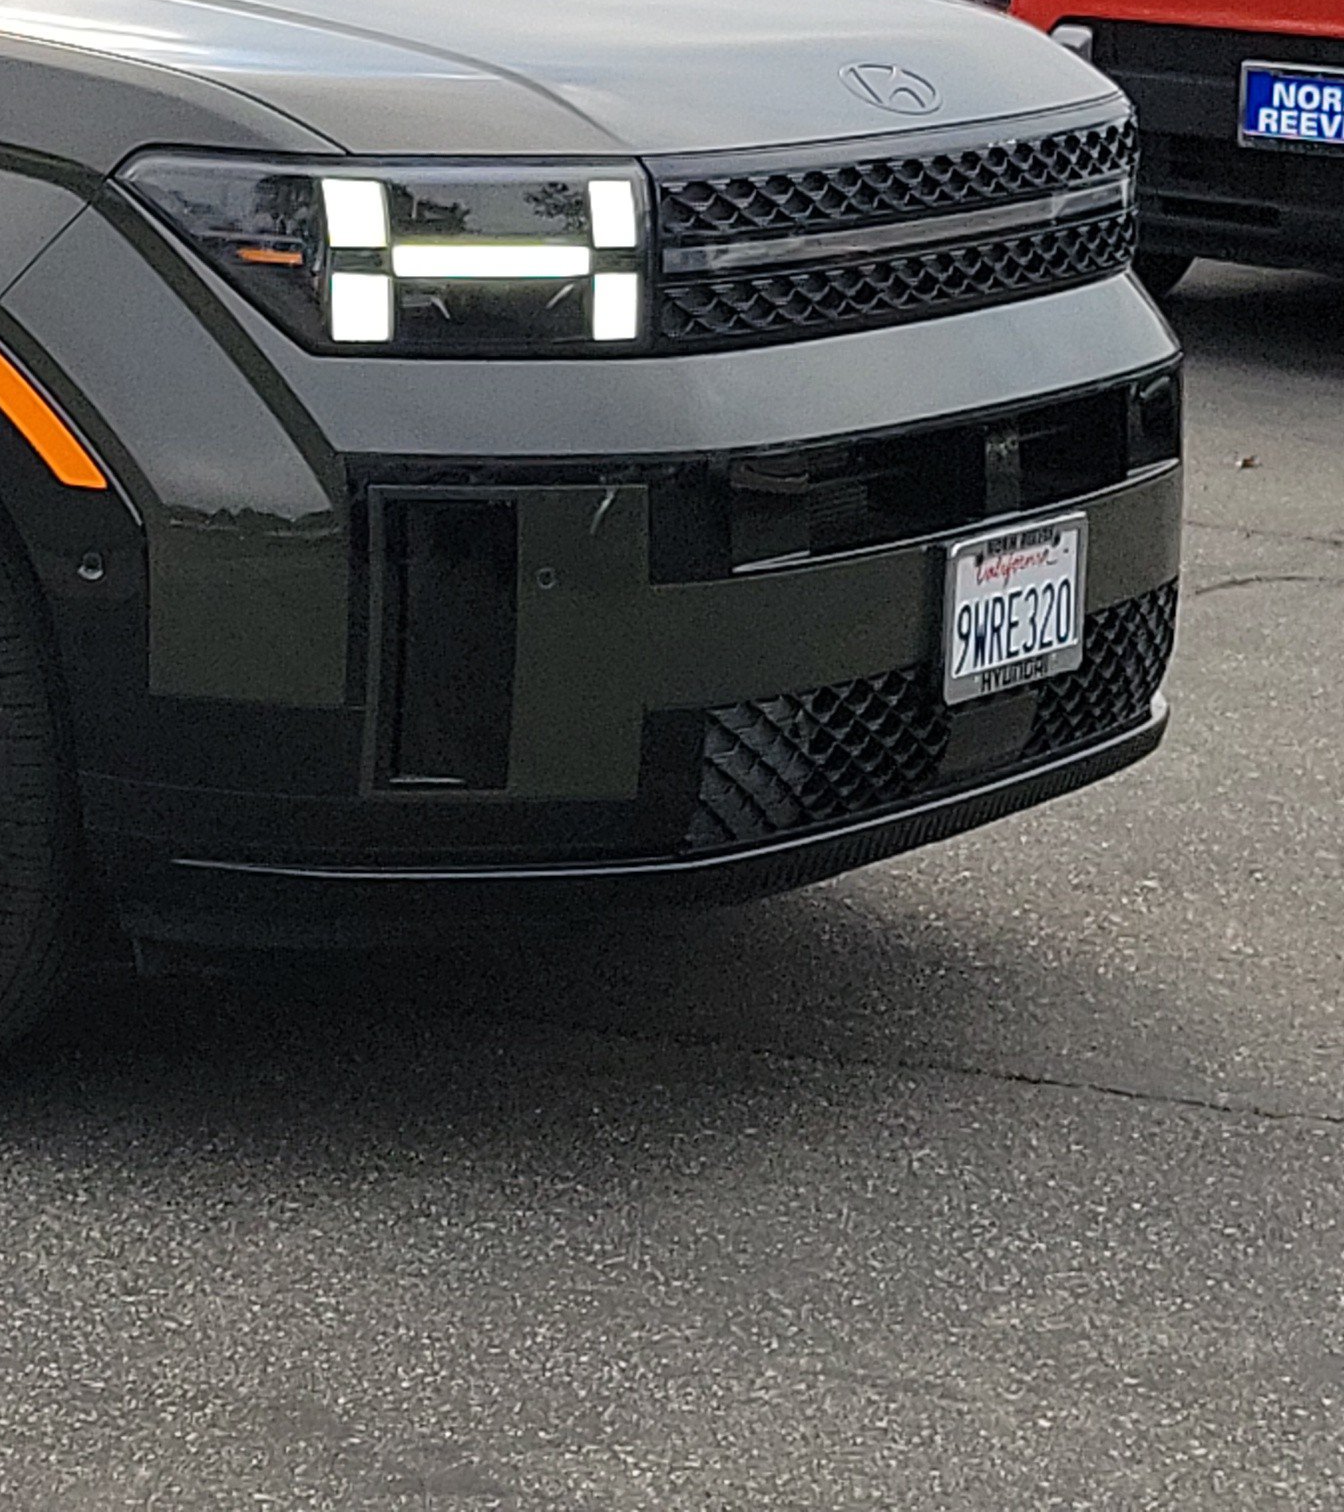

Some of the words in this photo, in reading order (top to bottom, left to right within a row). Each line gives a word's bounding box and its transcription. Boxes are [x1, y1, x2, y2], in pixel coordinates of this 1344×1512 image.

[1272, 82, 1344, 113] NOR
[1257, 107, 1344, 138] REEV
[955, 578, 1072, 676] 9WRE320
[980, 657, 1049, 693] HYUNDAI
